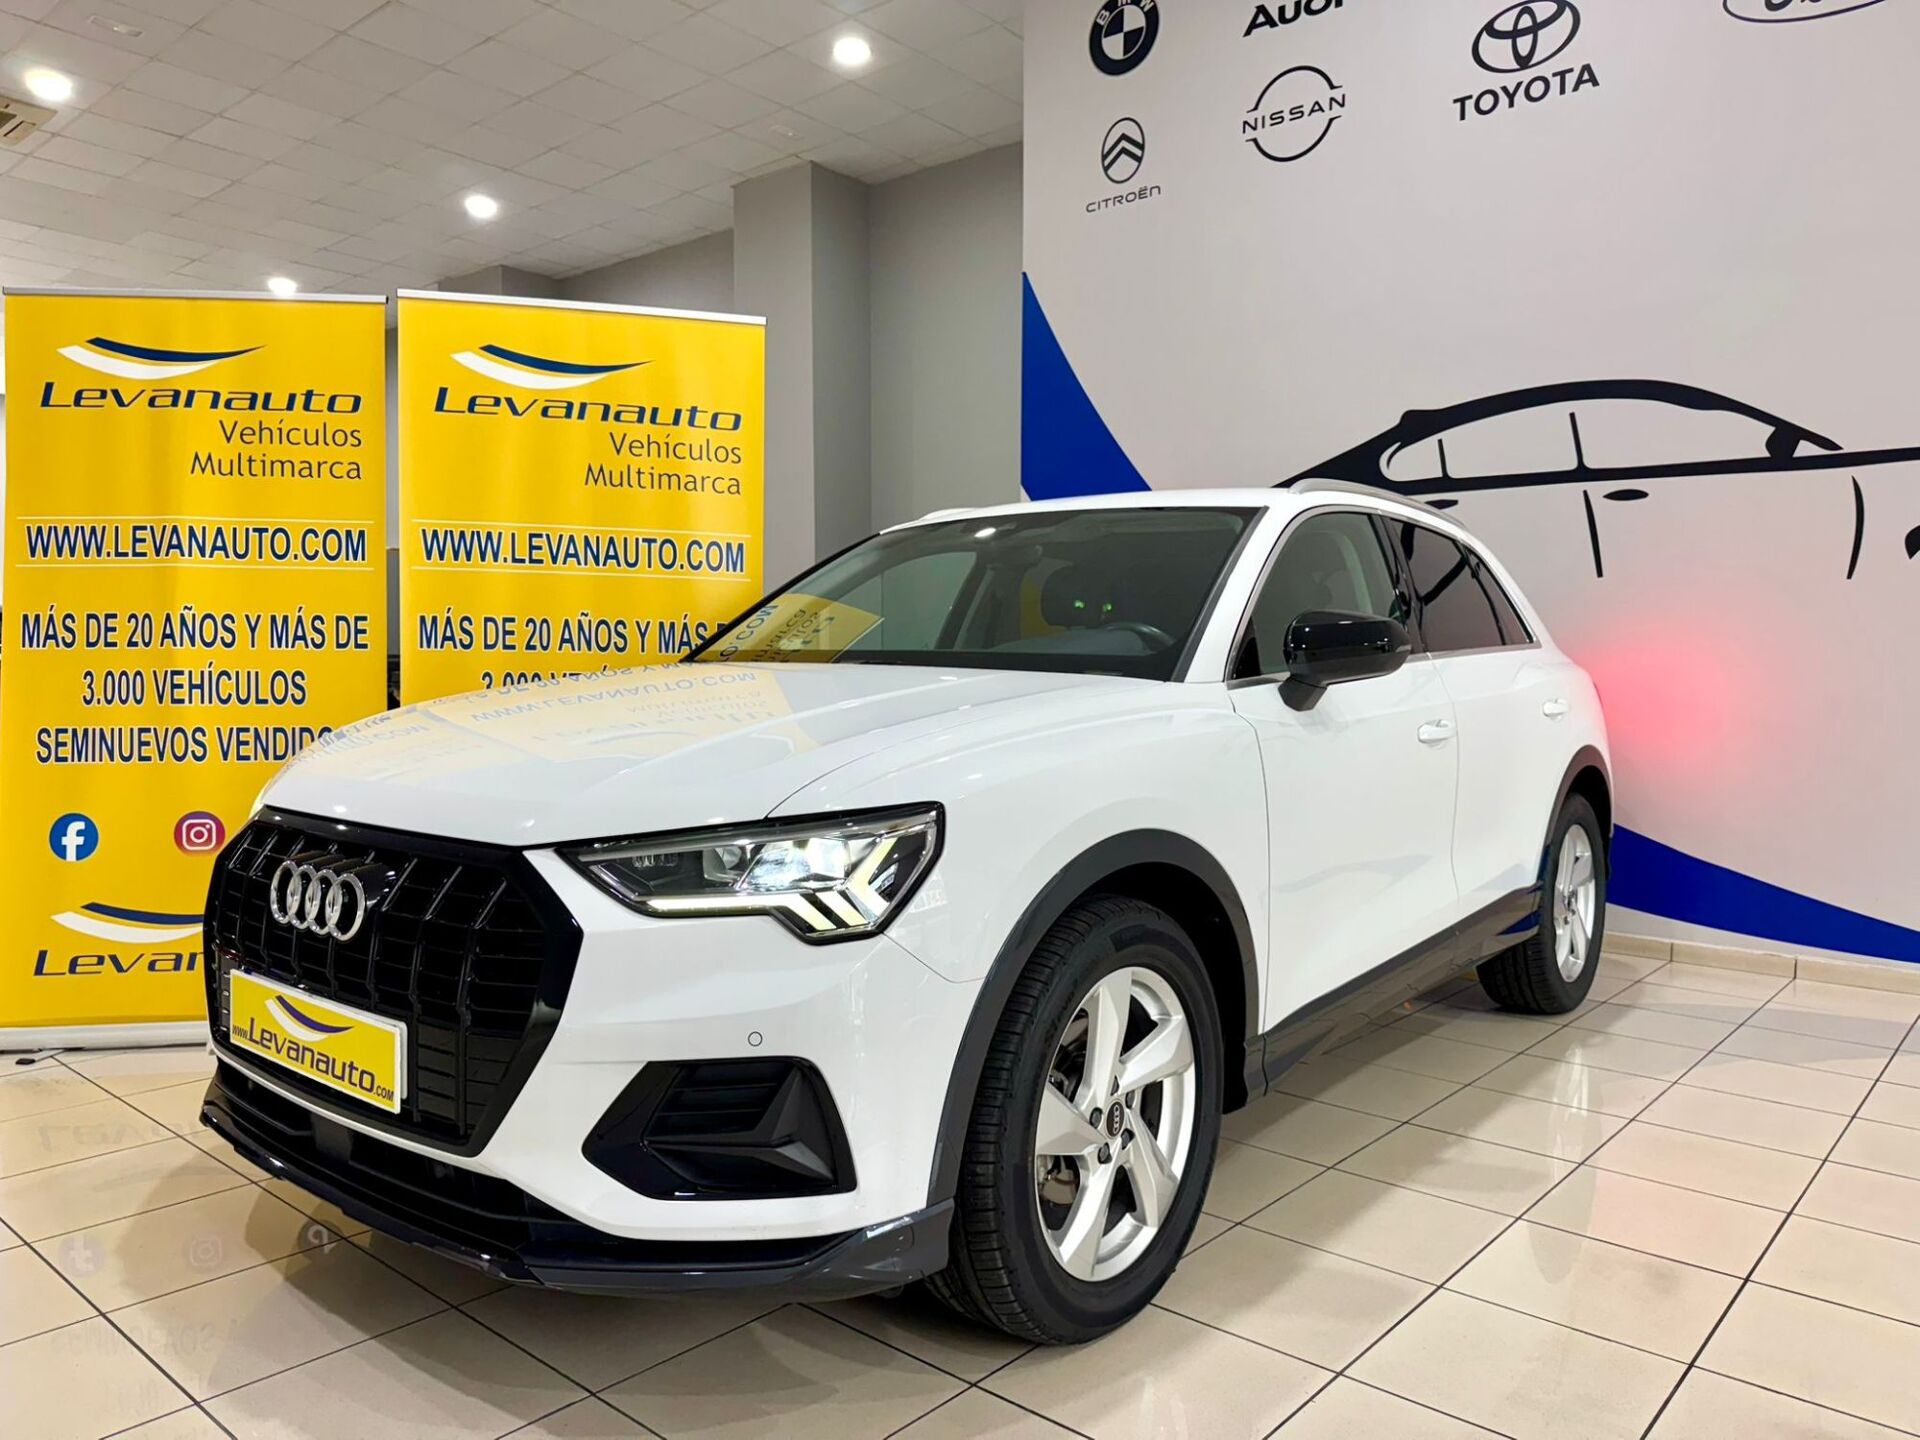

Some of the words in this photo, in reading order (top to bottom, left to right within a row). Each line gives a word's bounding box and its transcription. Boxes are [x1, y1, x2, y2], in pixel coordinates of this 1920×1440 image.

[1453, 63, 1600, 121] TOYOTA
[1242, 94, 1346, 135] NISSAN
[40, 382, 362, 413] Levanauto
[434, 386, 742, 432] Levanauto
[219, 420, 362, 448] Vehículos
[609, 432, 742, 464] Vehículos
[190, 452, 362, 480] Multimarca
[584, 463, 742, 496] Multimarca
[26, 524, 367, 562] WWW.LEVANAUTO.COM
[421, 528, 744, 573] WWW.LEVANAUTO.COM
[21, 604, 77, 649] MÁS
[85, 613, 118, 648] DE
[126, 612, 153, 648] 20
[159, 605, 236, 649] AÑOS
[244, 614, 261, 648] Y
[270, 606, 326, 650] MÁS
[335, 615, 369, 650] DE
[419, 607, 474, 651] MÁS
[483, 616, 517, 651] DE
[524, 617, 551, 652] 20
[558, 612, 628, 653] AÑOS
[635, 620, 651, 653] Y
[658, 614, 708, 654] MÁS
[82, 670, 145, 706] 3.000
[153, 661, 306, 706] VEHÍCULOS
[36, 726, 208, 764] SEMINUEVOS
[216, 726, 333, 763] VENDID
